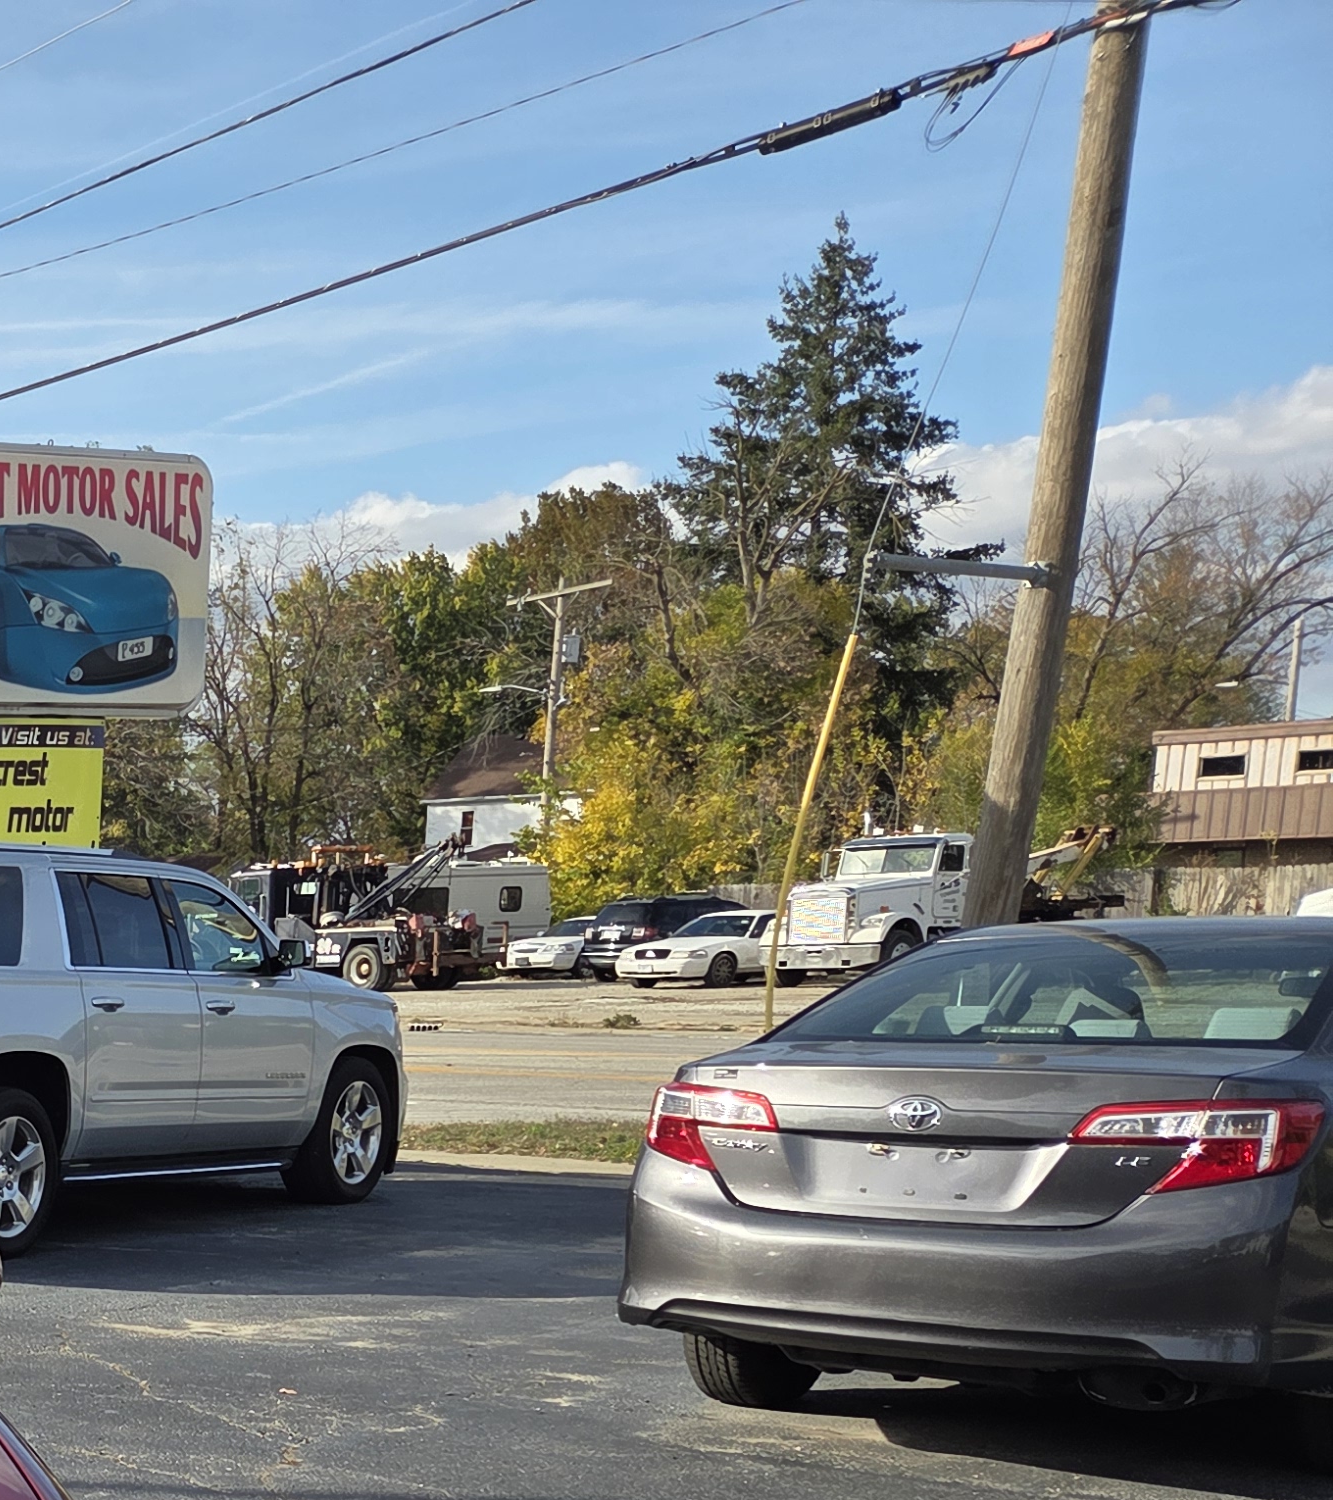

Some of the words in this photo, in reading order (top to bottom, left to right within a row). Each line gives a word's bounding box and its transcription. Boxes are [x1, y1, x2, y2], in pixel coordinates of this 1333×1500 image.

[17, 463, 117, 521] MOTOR
[124, 469, 204, 560] SALES
[1, 727, 40, 745] Visit
[46, 731, 70, 745] us
[74, 728, 95, 746] at:
[7, 799, 74, 833] motor
